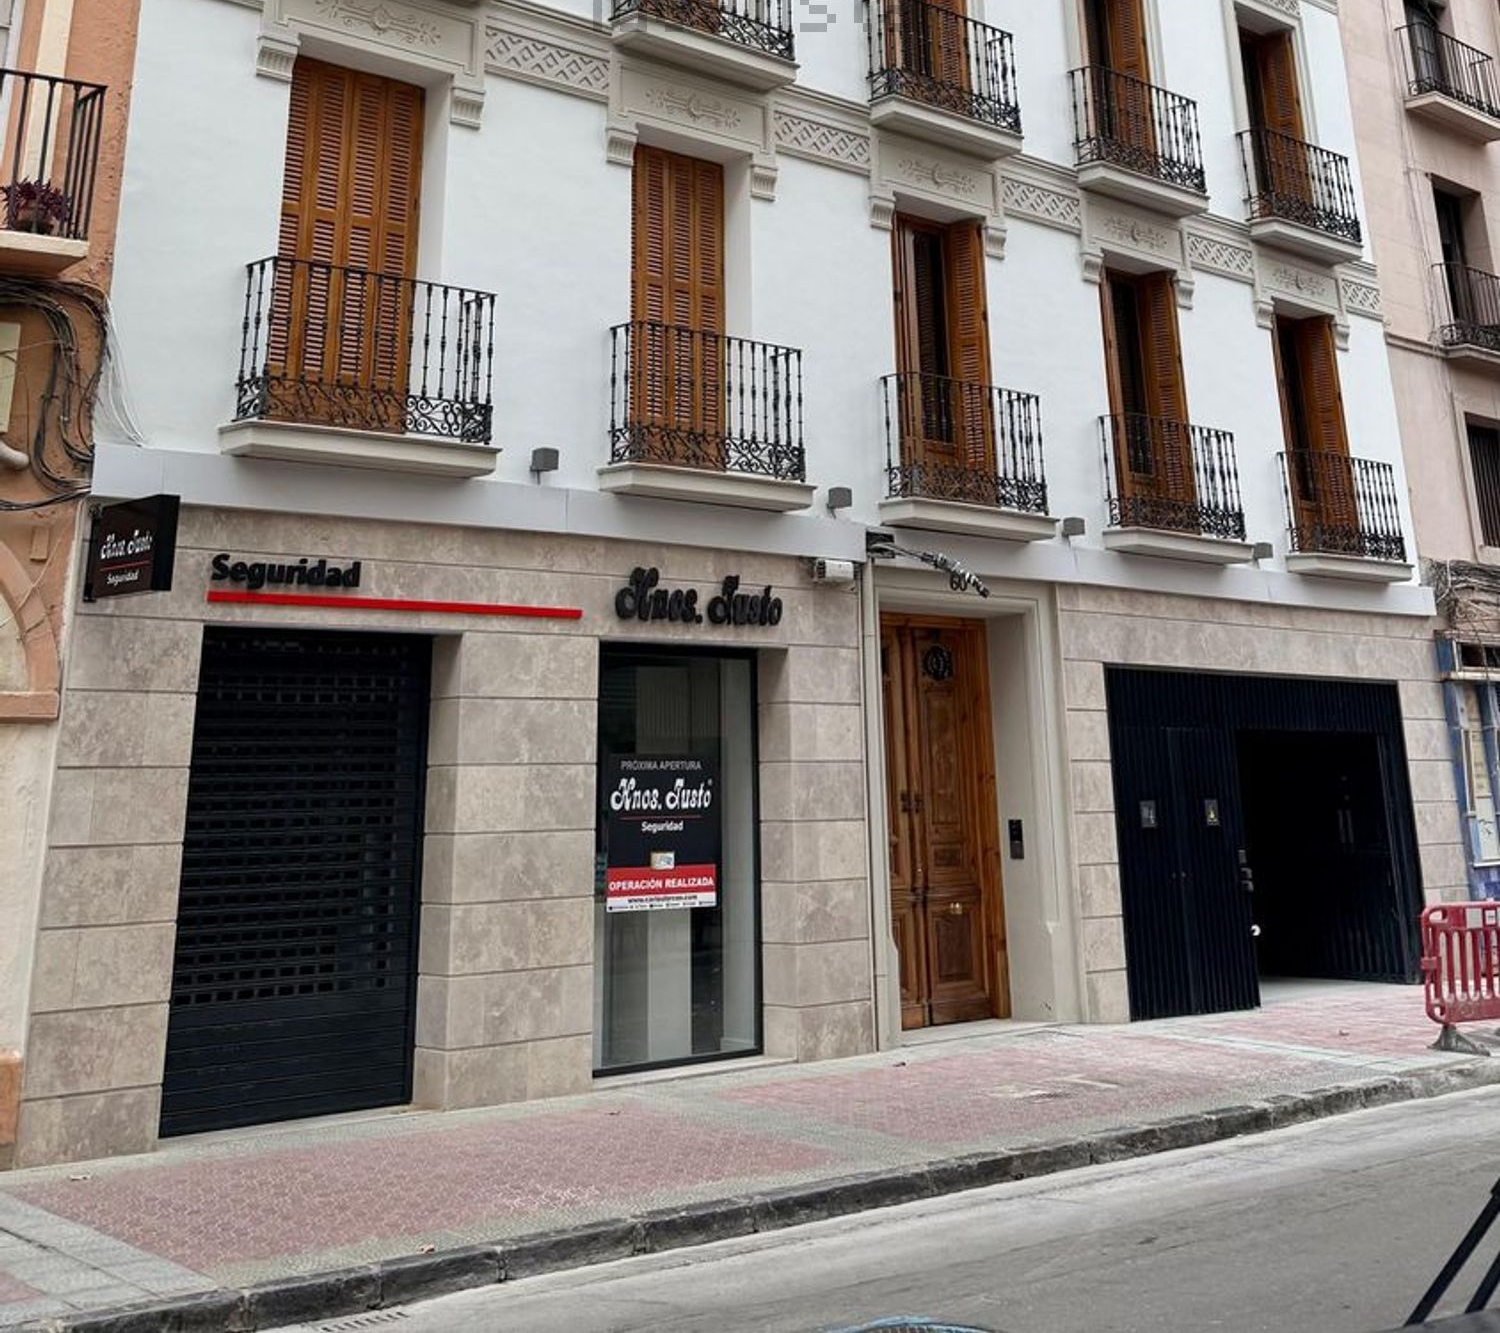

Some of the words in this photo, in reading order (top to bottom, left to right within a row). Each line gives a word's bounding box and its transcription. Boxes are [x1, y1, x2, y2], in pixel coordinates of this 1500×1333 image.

[107, 570, 139, 586] Seguridad
[211, 553, 362, 589] Seguridad
[659, 760, 702, 770] APERTURA
[641, 820, 684, 834] Seguridad
[609, 878, 663, 891] OPERACIÓN
[664, 876, 714, 888] REALIZADA
